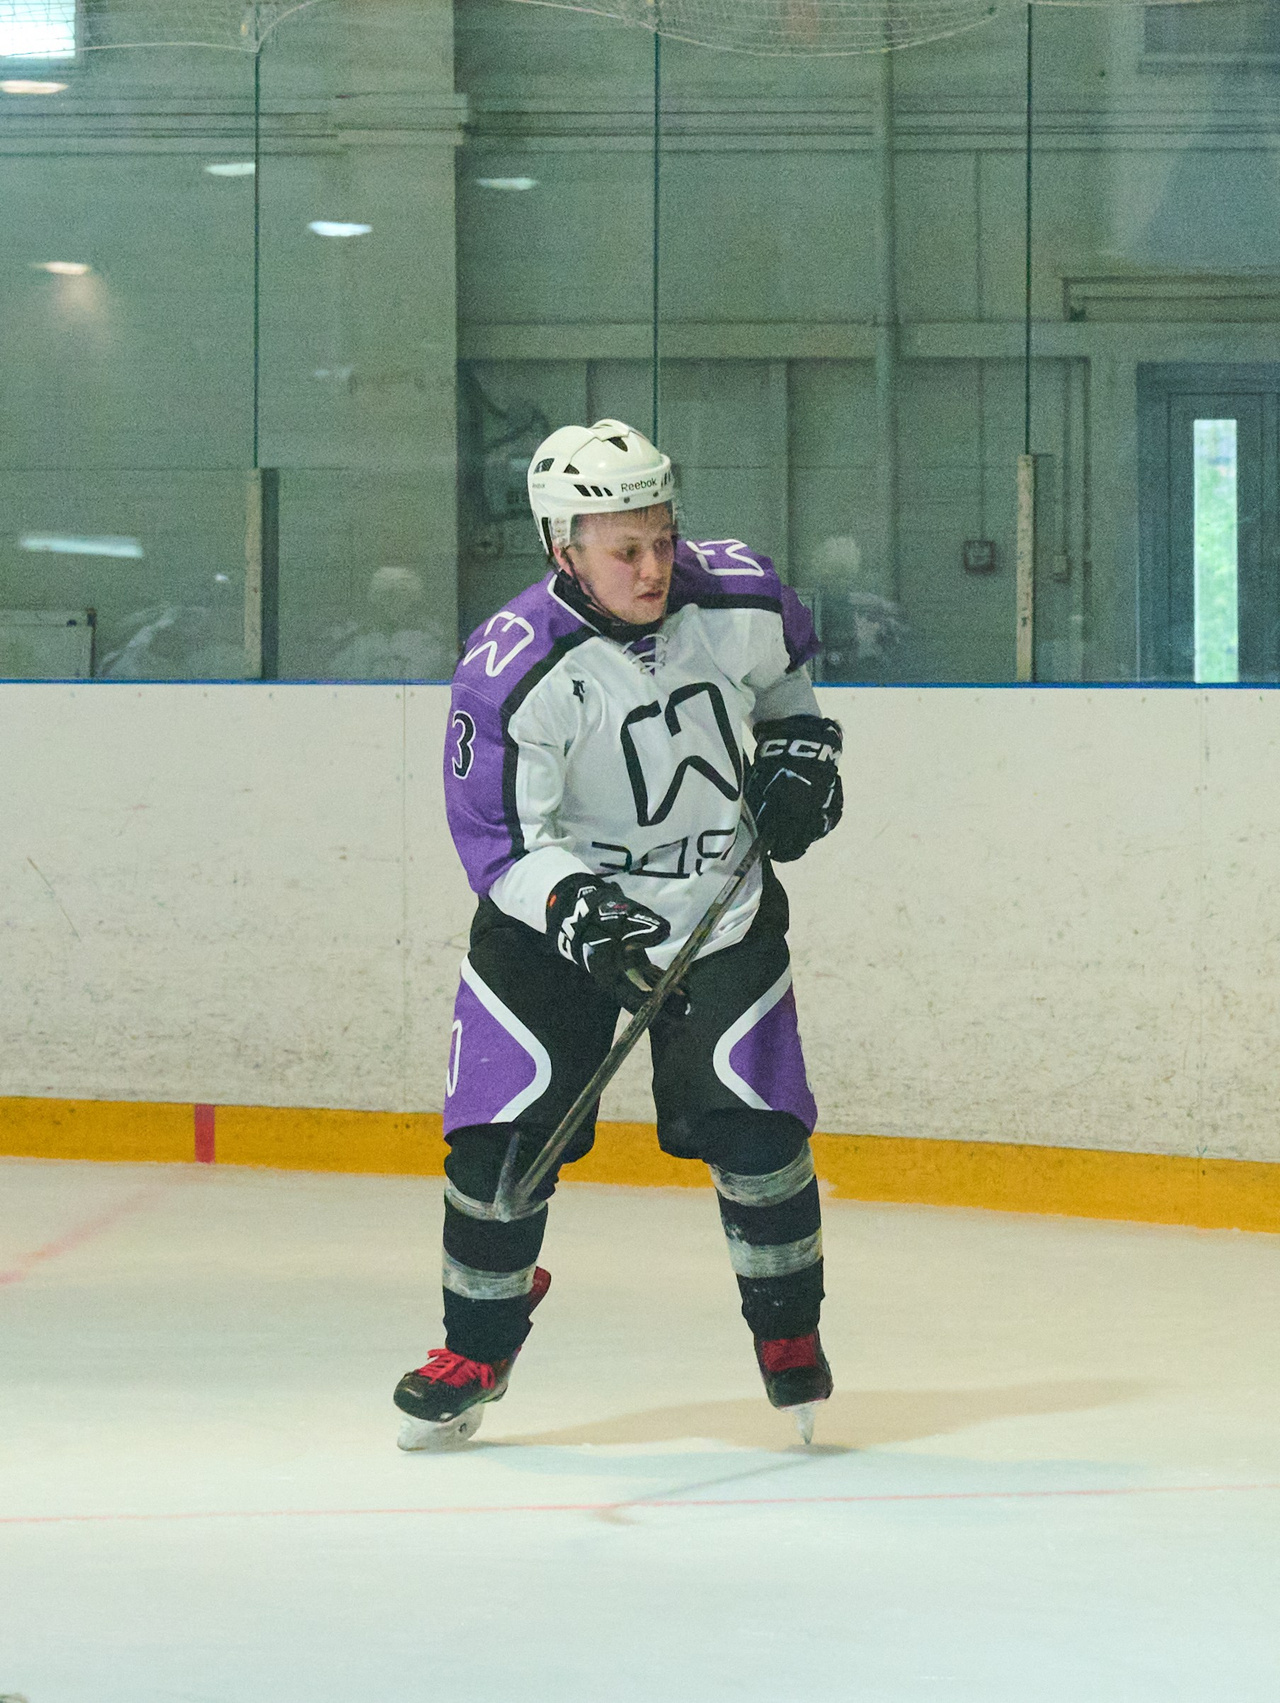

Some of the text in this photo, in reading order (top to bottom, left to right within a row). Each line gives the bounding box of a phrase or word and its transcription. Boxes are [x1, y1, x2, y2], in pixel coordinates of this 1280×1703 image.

[621, 477, 658, 492] Reebok
[452, 710, 477, 780] 3
[760, 738, 842, 762] CCM
